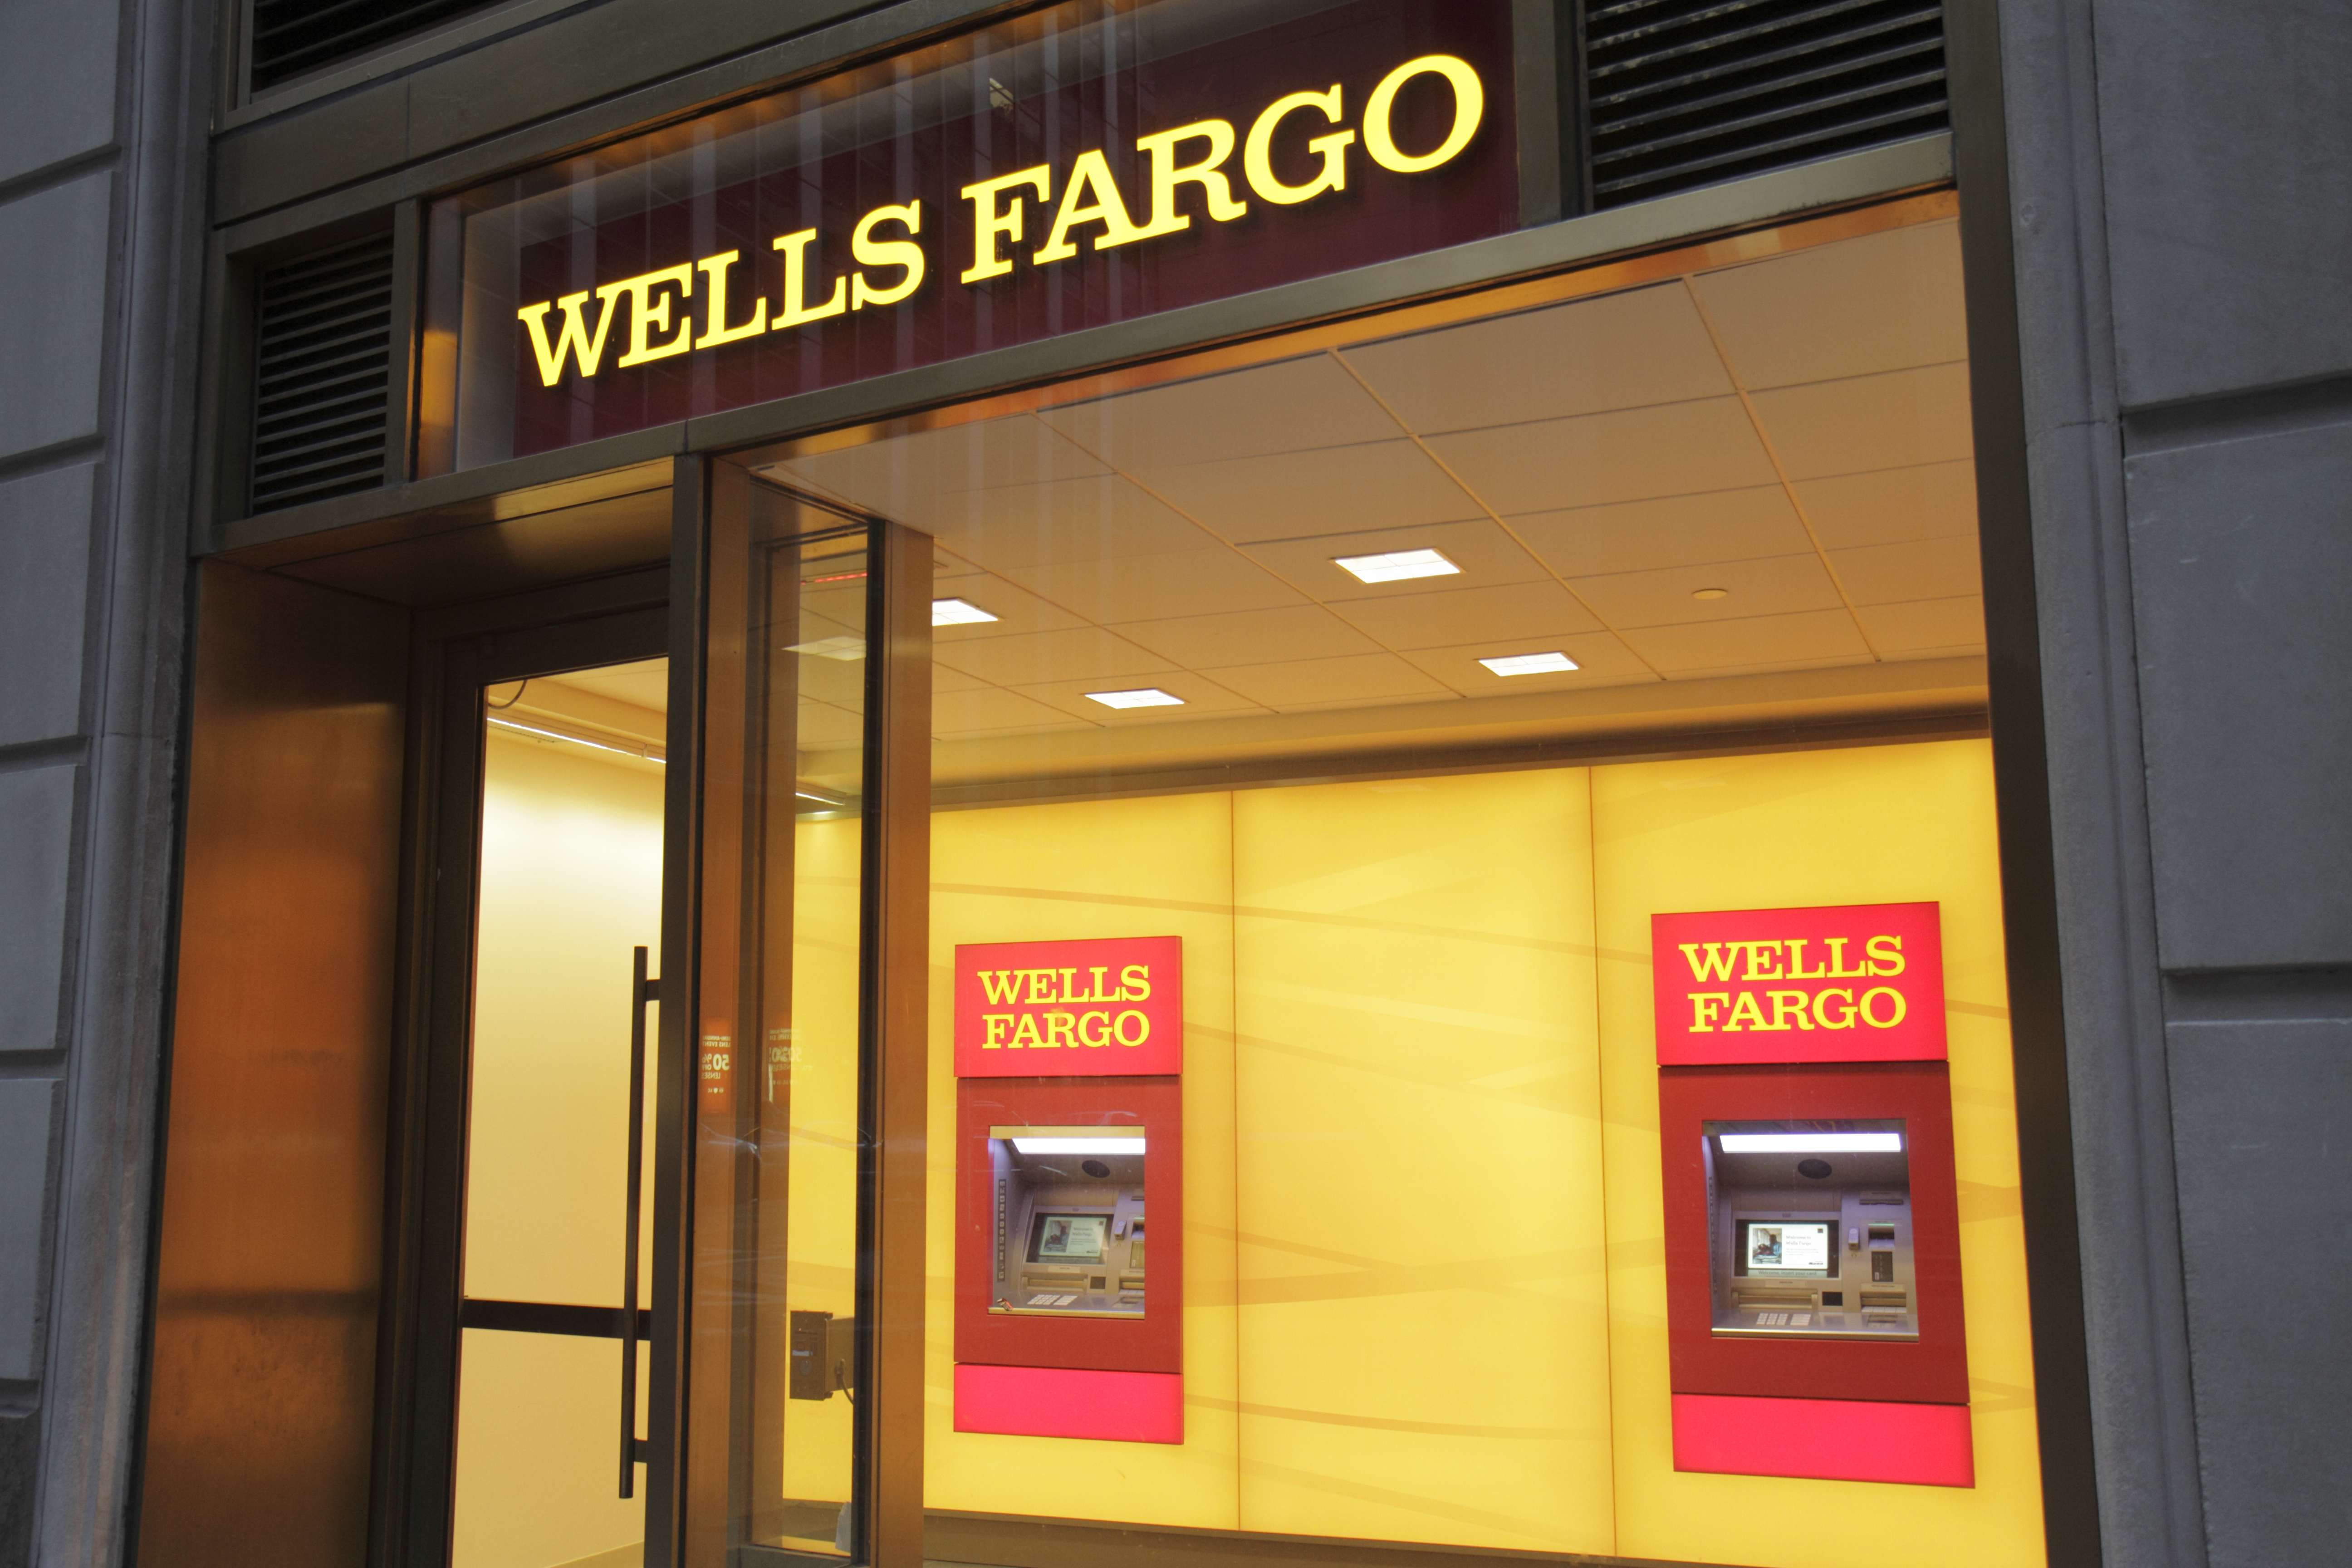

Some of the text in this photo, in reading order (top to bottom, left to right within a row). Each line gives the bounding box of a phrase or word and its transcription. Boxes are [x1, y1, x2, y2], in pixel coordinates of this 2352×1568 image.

[517, 54, 1484, 387] WELLS FARGO
[1678, 935, 1906, 983] WELLS
[976, 964, 1151, 1005] WELLS
[981, 1009, 1150, 1049] FARGO
[1687, 986, 1907, 1033] FARGO
